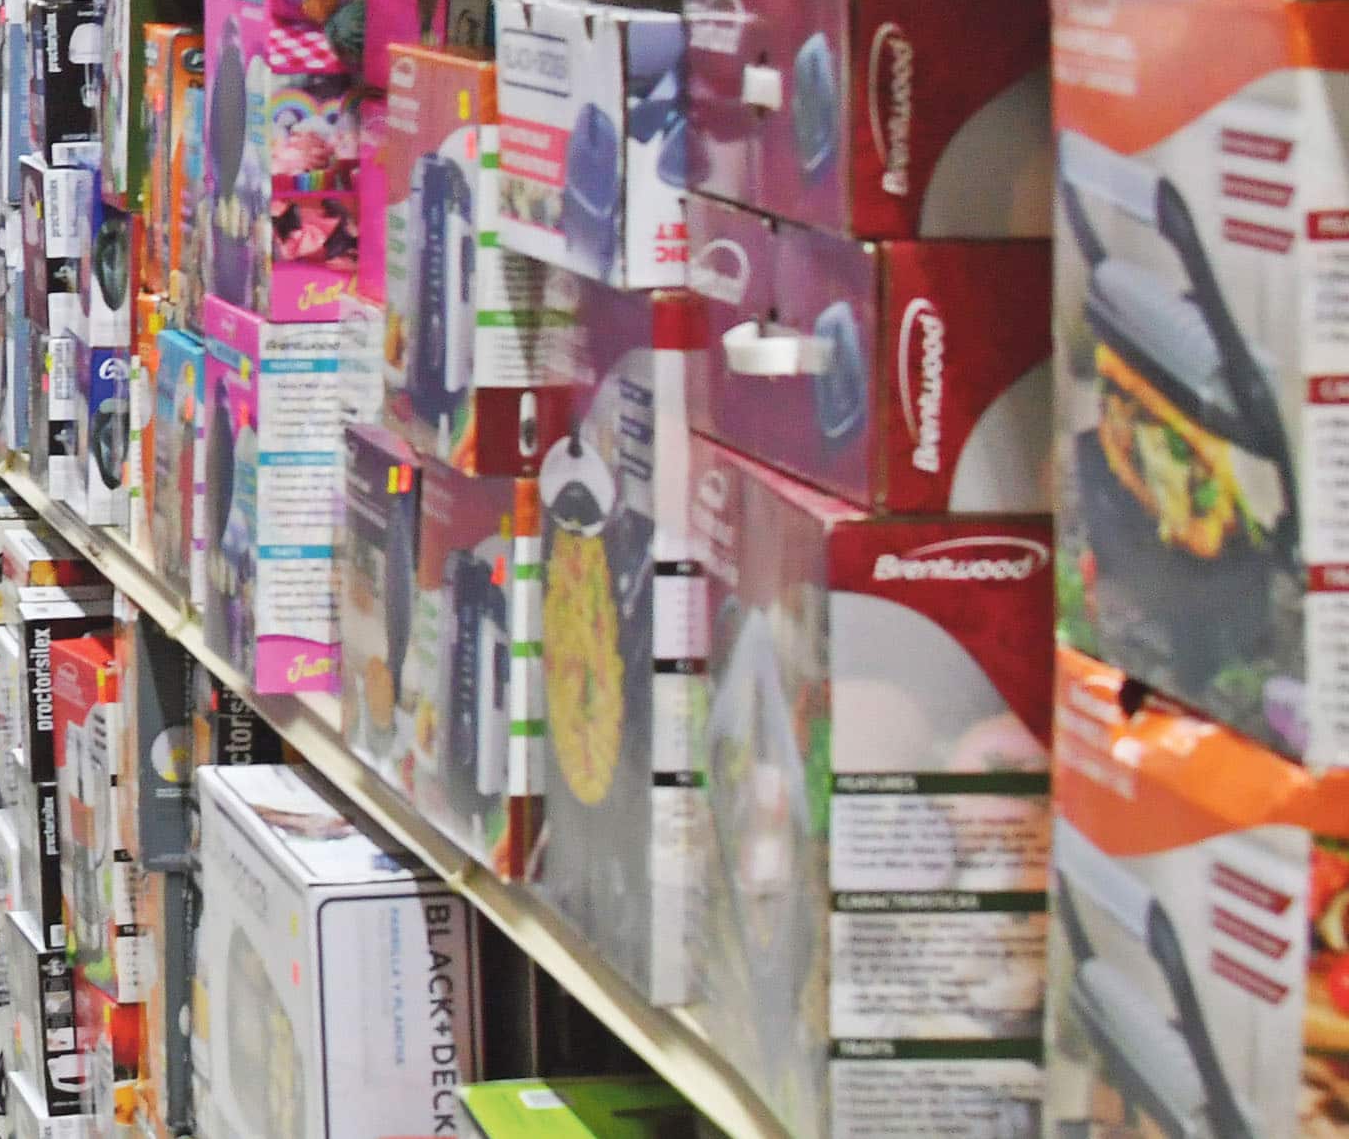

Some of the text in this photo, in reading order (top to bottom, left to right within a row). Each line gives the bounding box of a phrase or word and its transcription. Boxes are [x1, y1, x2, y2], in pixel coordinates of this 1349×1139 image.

[875, 30, 912, 195] Brentwood
[905, 305, 944, 472] Brentwood
[873, 544, 1041, 581] Brentwood
[34, 627, 53, 731] proctorsilex
[425, 902, 458, 1134] BLACK+DECK
